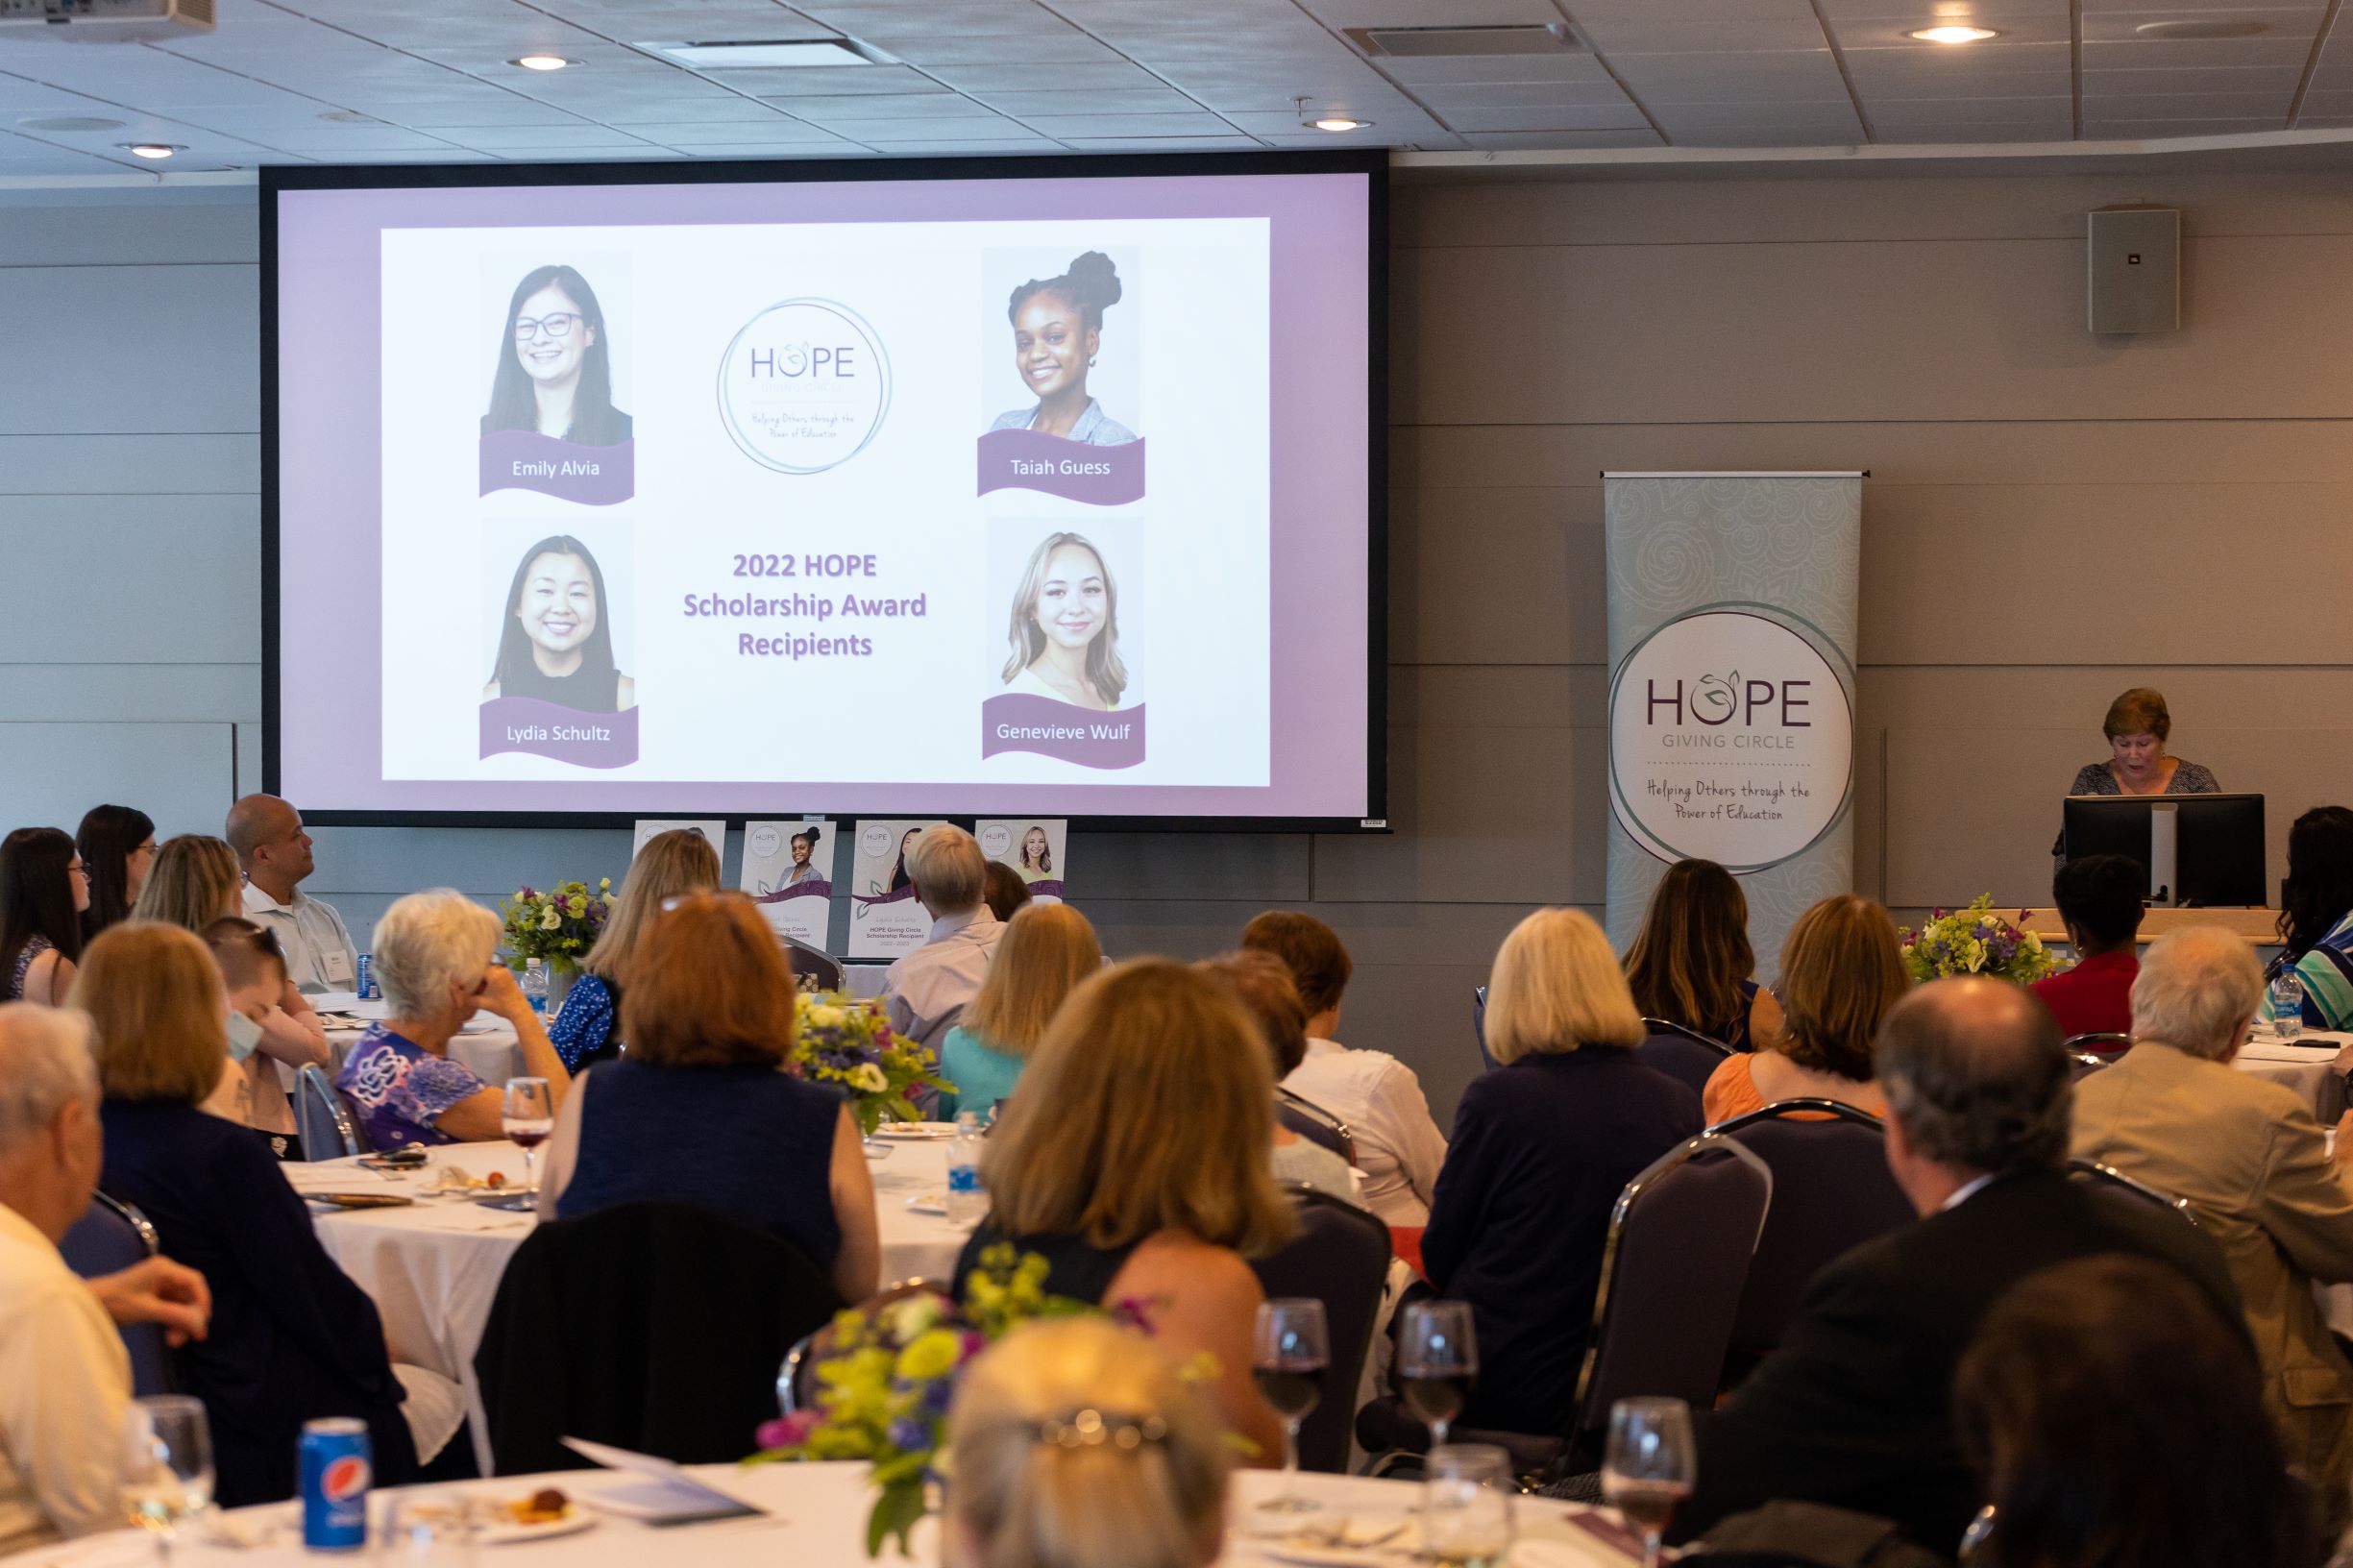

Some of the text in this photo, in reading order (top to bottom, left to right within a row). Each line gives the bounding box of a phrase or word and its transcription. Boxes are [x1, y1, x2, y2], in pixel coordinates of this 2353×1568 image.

[750, 343, 855, 378] HOPE
[751, 412, 854, 428] Helping Others through the
[769, 427, 837, 438] Power of Education
[512, 460, 600, 478] Emily Alvia
[1010, 459, 1111, 475] Taiah Guess
[733, 553, 877, 577] 2022 HOPE
[683, 592, 927, 622] Scholarship Award
[738, 631, 872, 661] Recipients
[1647, 671, 1811, 727] HOPE
[507, 725, 611, 744] Lydia Schultz
[996, 723, 1131, 740] Genevieve Wulf
[1661, 734, 1796, 749] GIVING CIRCLE
[1647, 779, 1810, 804] Helping Others through the
[1674, 802, 1783, 821] Power of Education
